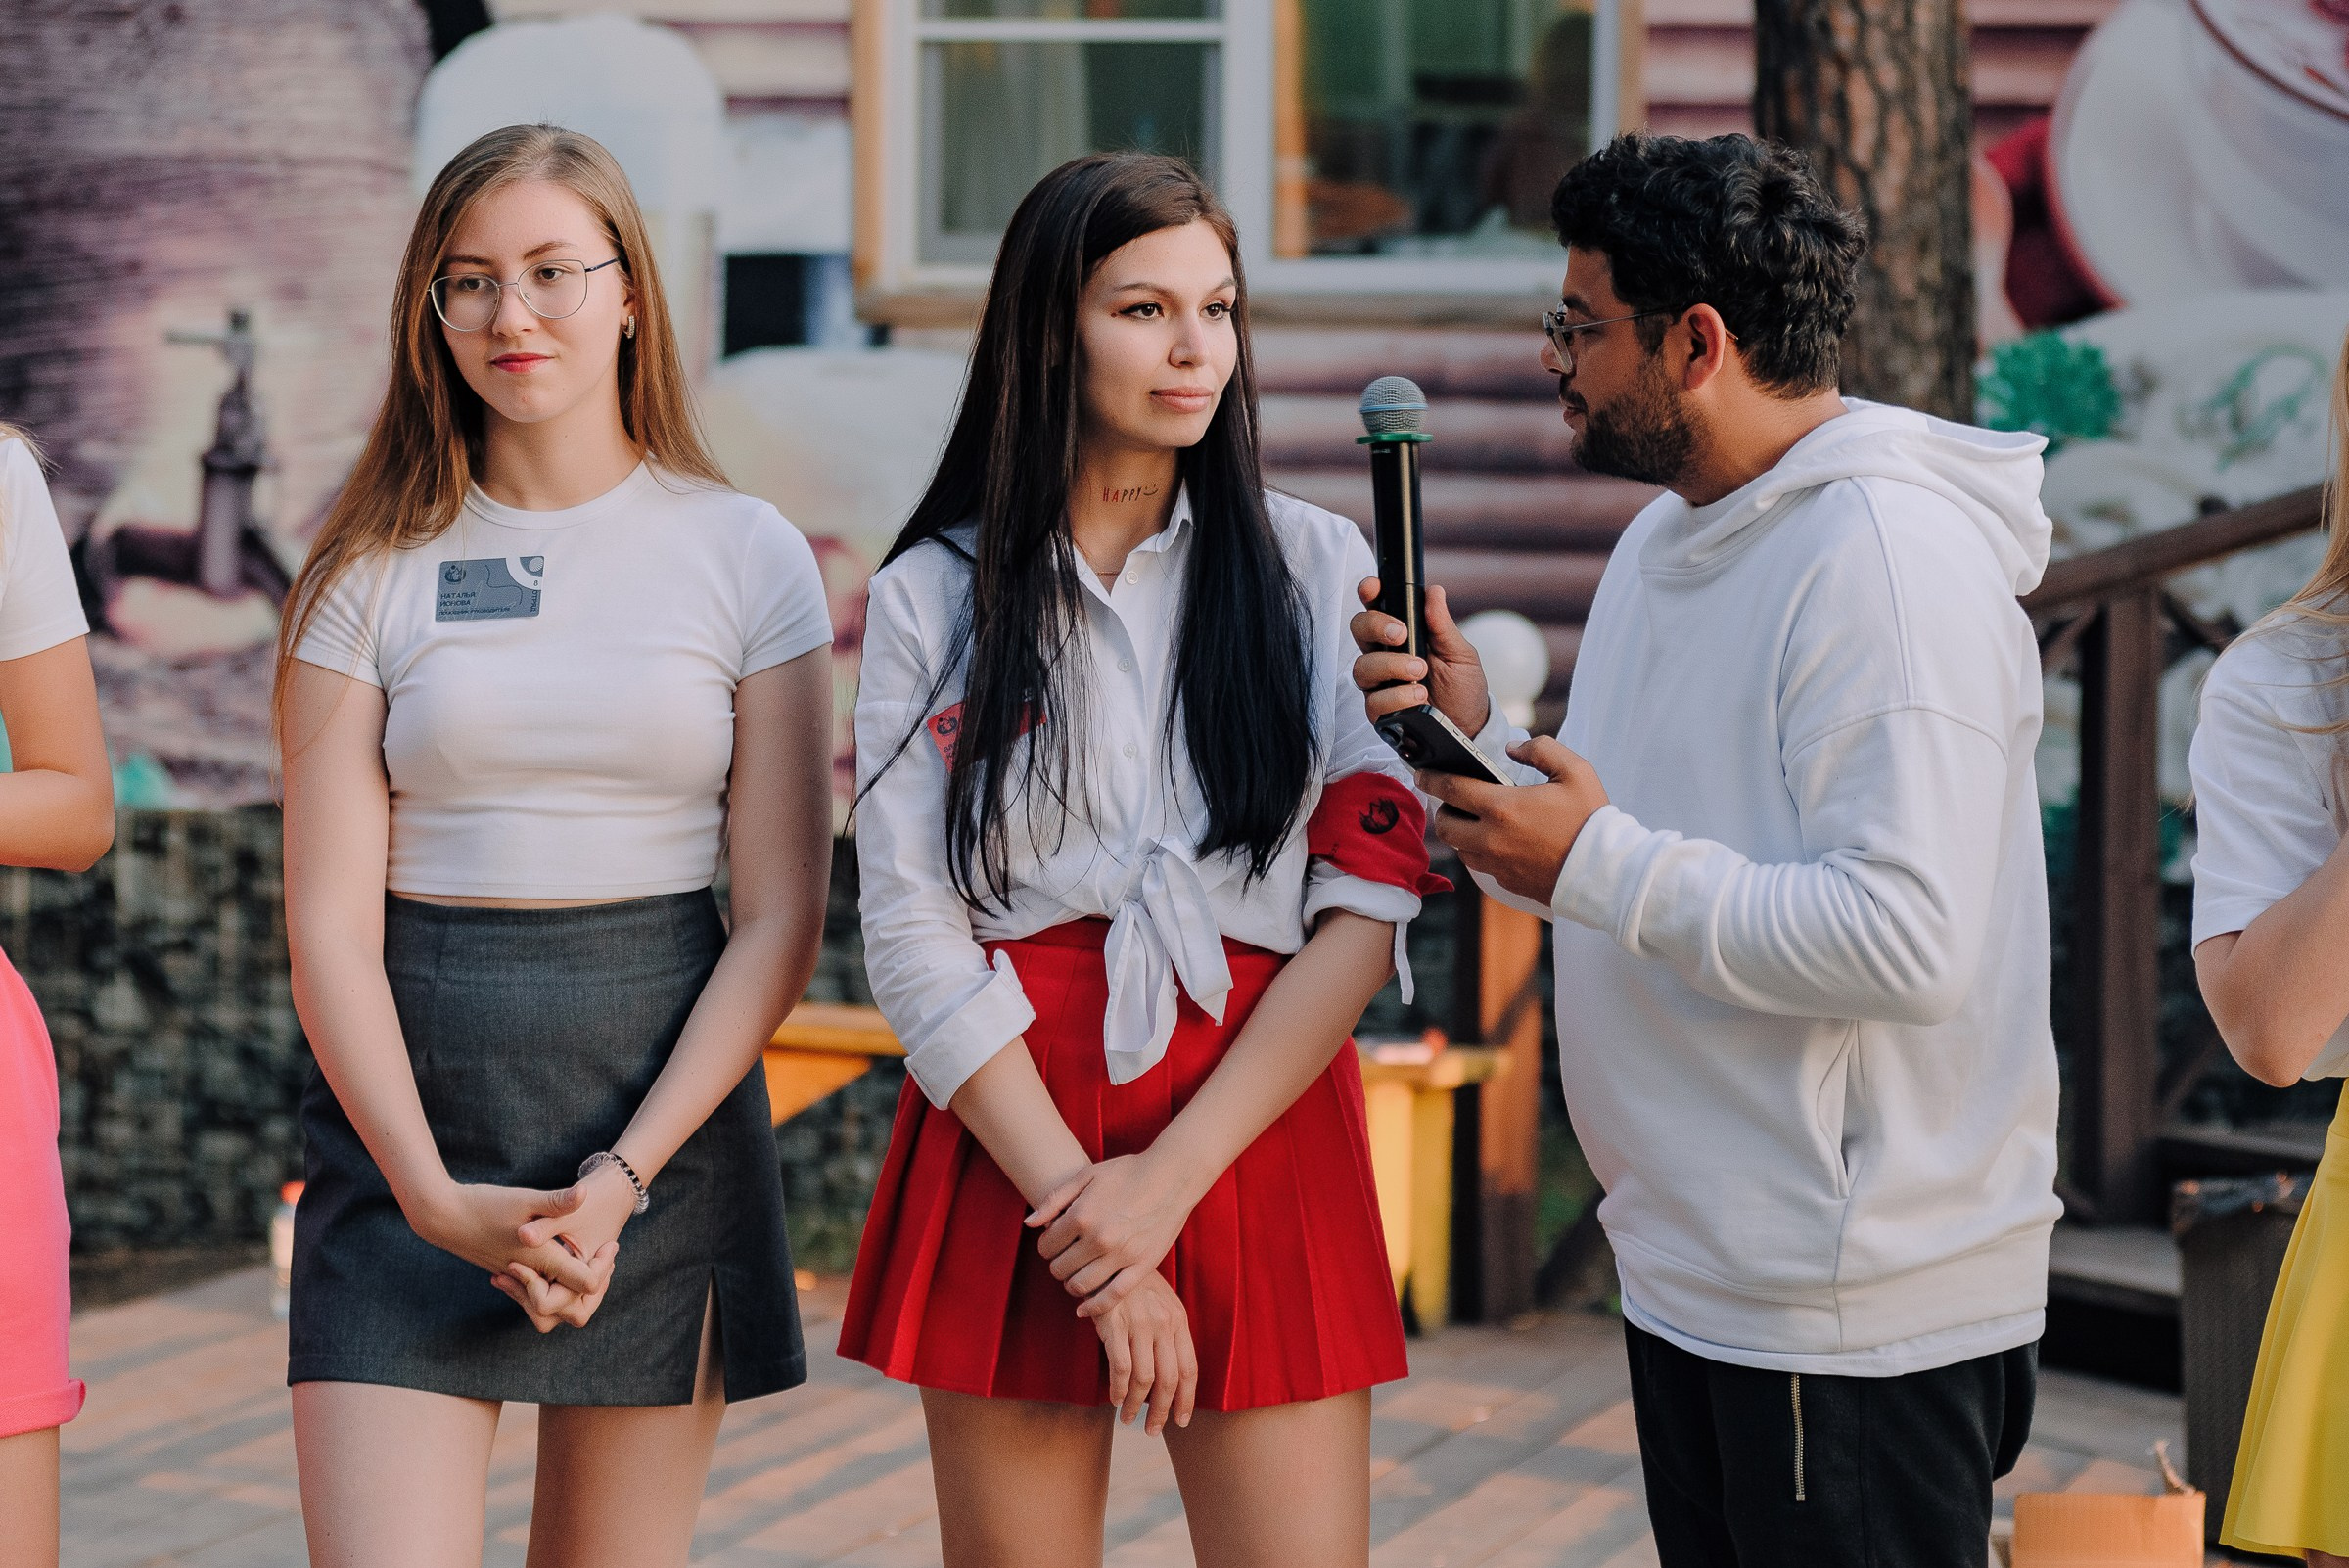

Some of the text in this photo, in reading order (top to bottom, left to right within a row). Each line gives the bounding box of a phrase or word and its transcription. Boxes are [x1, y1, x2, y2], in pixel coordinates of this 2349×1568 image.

[1102, 486, 1142, 503] HAPPY
[440, 591, 476, 600] НАТАЛЬЯ
[530, 590, 538, 613] ОТРЯД
